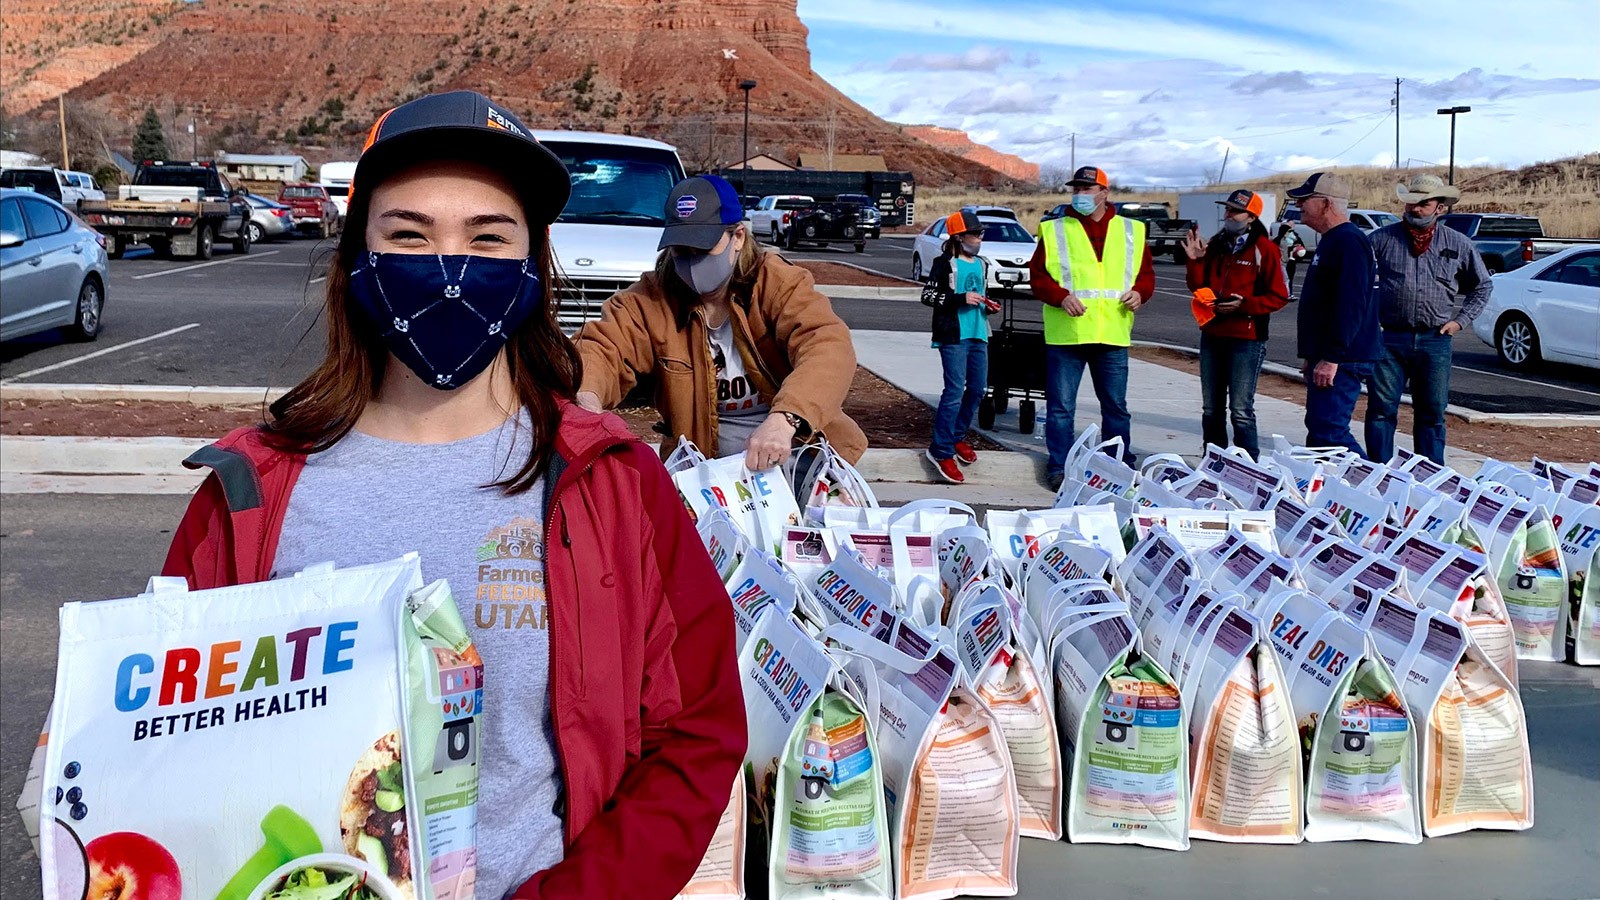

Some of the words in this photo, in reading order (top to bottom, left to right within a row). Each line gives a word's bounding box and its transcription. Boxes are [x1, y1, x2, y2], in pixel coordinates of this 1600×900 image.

[721, 48, 739, 59] K
[700, 472, 772, 507] CRAE
[1552, 514, 1600, 548] RATE
[709, 534, 727, 570] REATE
[478, 565, 544, 582] Farme
[732, 578, 776, 623] CREAT
[817, 569, 877, 627] CREACIONE
[822, 597, 834, 612] COCINA
[832, 607, 841, 619] PARA
[1270, 611, 1350, 677] REACONES
[1271, 639, 1285, 656] OCINA
[114, 621, 358, 712] CREATE
[753, 637, 811, 713] CREACIONES
[1316, 674, 1332, 687] SALUD
[1408, 670, 1430, 684] mpras
[134, 706, 225, 741] BETTER
[234, 685, 327, 722] HEALTH
[756, 677, 770, 693] COCINA
[767, 689, 775, 702] PARA
[773, 698, 784, 713] MEJOR
[780, 709, 791, 723] SALUD
[880, 702, 897, 723] hopping
[897, 719, 907, 731] Cart
[940, 720, 956, 730] ction
